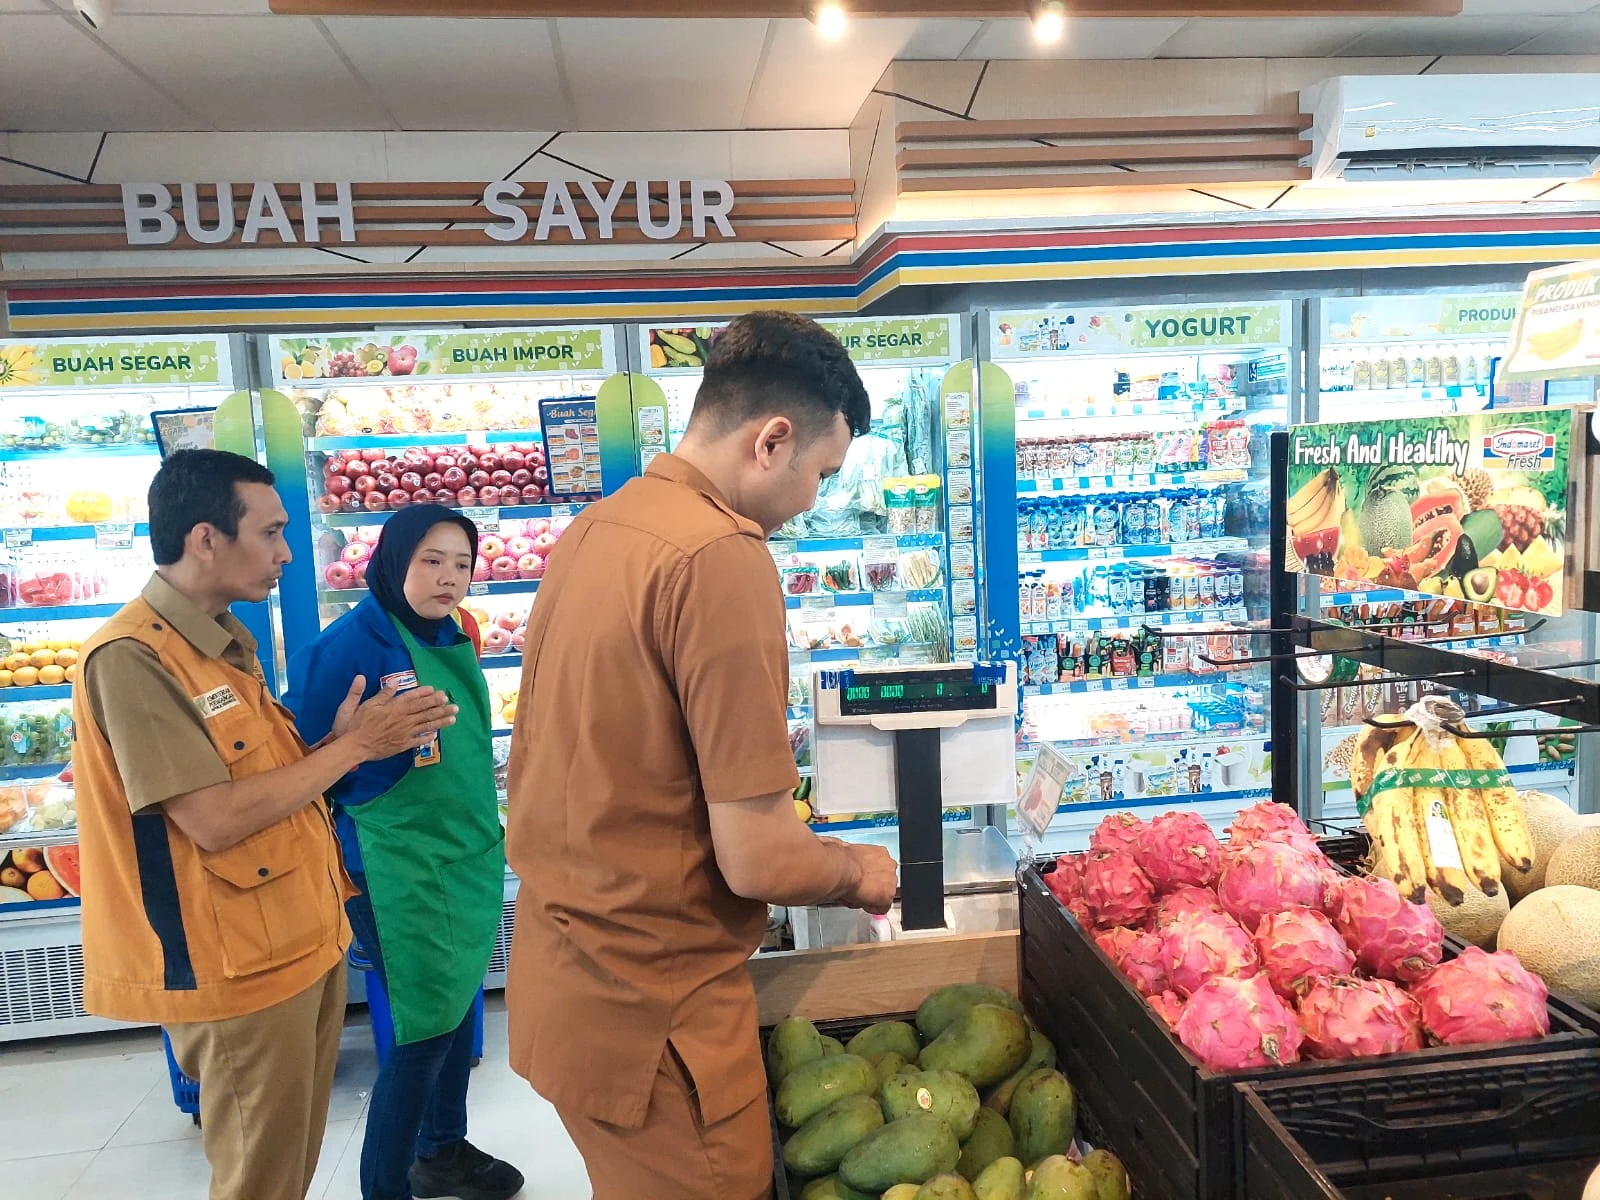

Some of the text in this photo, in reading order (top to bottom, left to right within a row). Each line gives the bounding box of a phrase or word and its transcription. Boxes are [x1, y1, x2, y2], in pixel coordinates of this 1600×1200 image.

[121, 179, 737, 244] BUAH SAYUR
[1534, 276, 1600, 303] PRODUK
[1145, 315, 1251, 338] YOGURT
[866, 332, 922, 348] SEGAR
[453, 344, 574, 363] BUAH IMPOR
[53, 354, 192, 373] BUAH SEGAR
[551, 408, 575, 419] Buah
[1294, 429, 1469, 476] Fresh And Healthy
[1495, 437, 1541, 449] Indomaret
